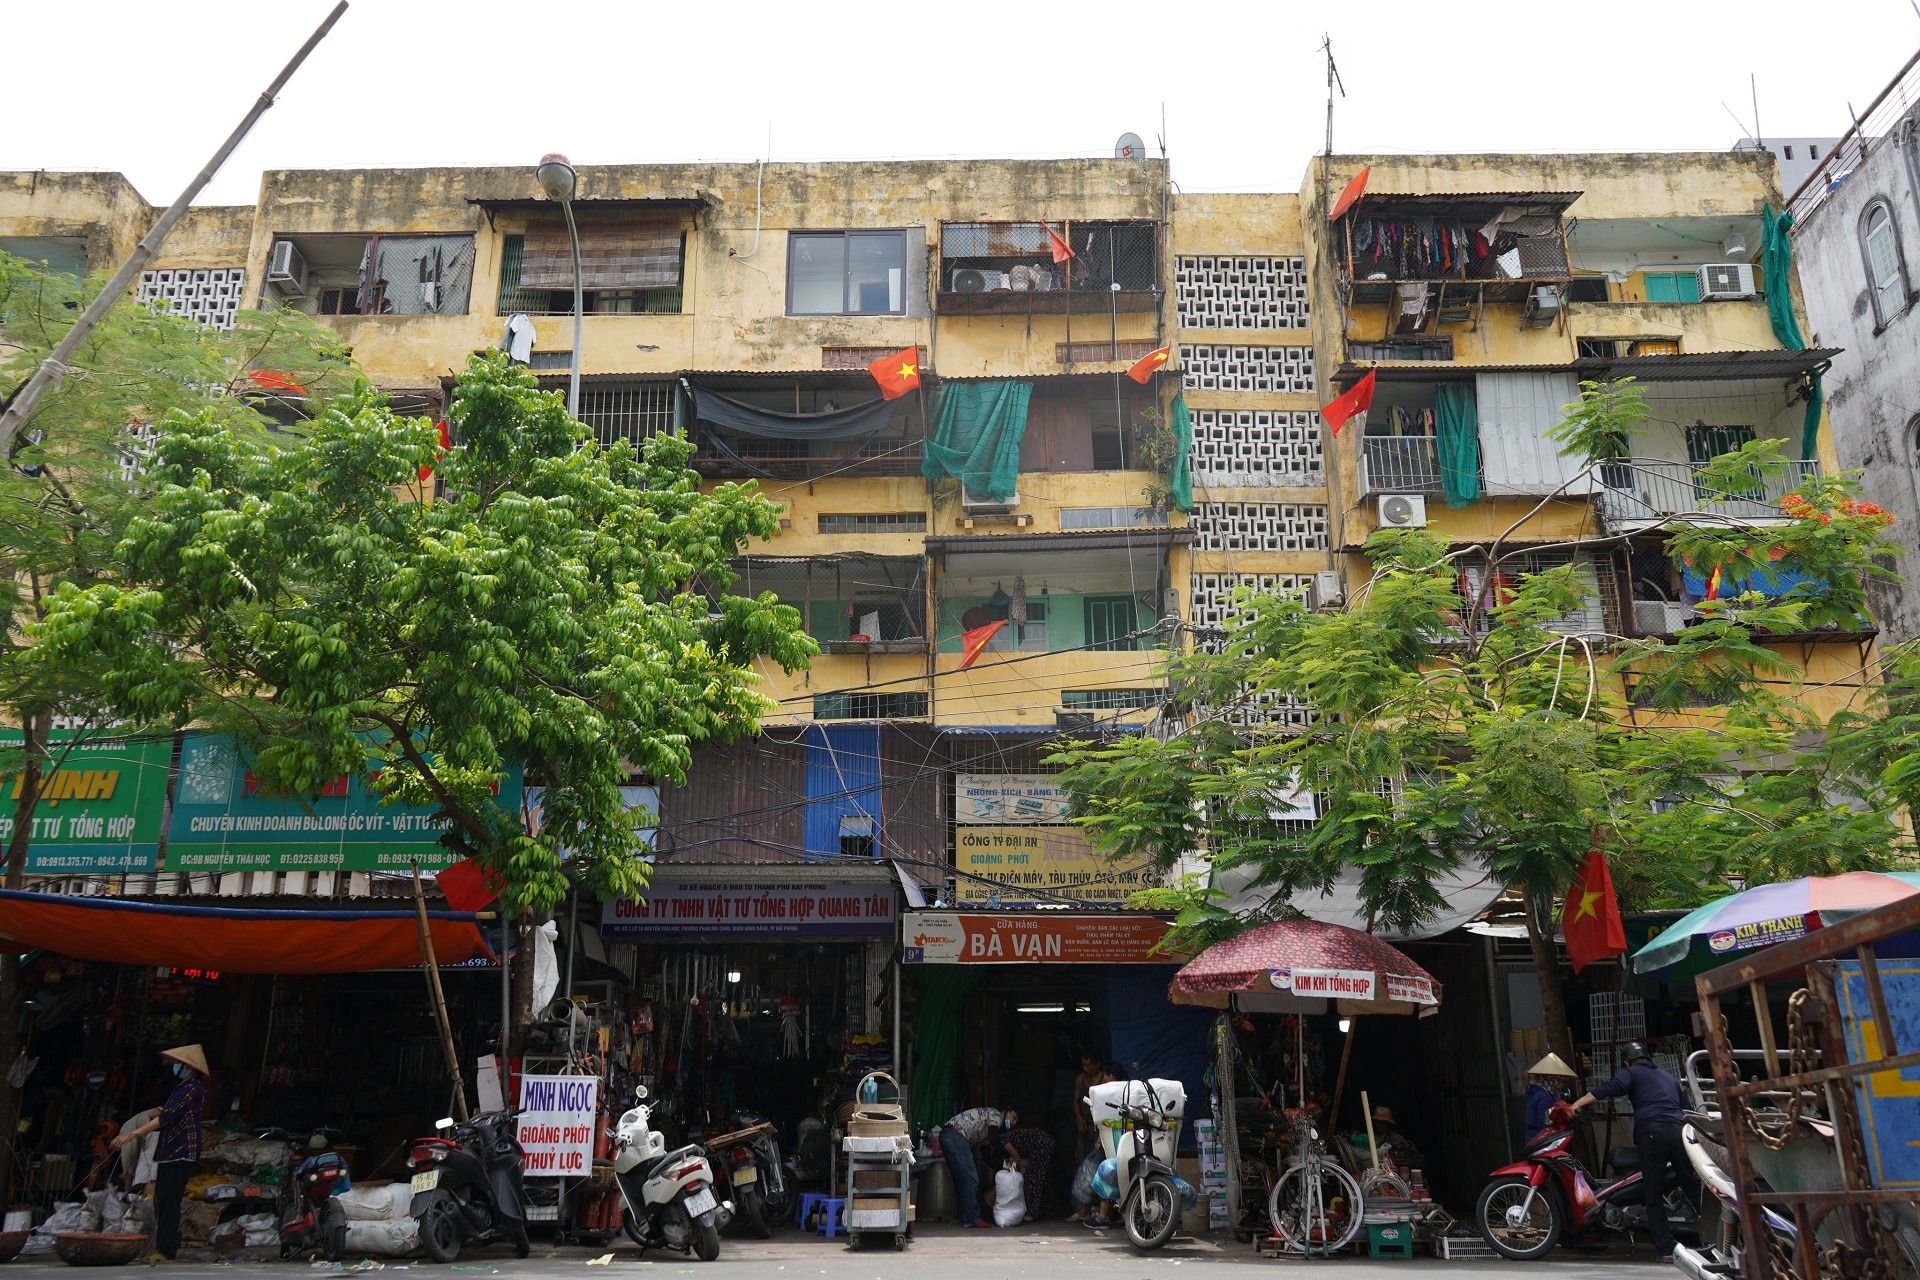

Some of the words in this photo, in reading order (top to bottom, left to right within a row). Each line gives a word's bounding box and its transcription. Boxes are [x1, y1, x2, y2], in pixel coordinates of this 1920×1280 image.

[43, 816, 63, 838] TƯ
[69, 809, 102, 838] TỔNG
[106, 815, 136, 841] HỢP
[190, 814, 234, 832] CHUYÊN
[236, 816, 262, 831] KINH
[264, 816, 301, 831] DOANH
[349, 810, 364, 830] ỐC
[366, 811, 384, 830] VÍT
[392, 813, 415, 833] VẬT
[963, 833, 990, 846] CÔNG
[993, 836, 1004, 846] TY
[1006, 836, 1021, 850] ĐẠI
[1025, 837, 1037, 847] AN
[204, 851, 234, 864] NGUYỄN
[236, 852, 254, 864] THÁI
[255, 854, 271, 866] HỌC
[1007, 852, 1030, 864] PHỚT
[1000, 870, 1020, 885] ĐIỆN
[1049, 870, 1066, 883] TÀU
[654, 899, 668, 918] TY
[672, 899, 704, 918] TNHH
[708, 894, 731, 922] VẬT
[734, 896, 751, 918] TƯ
[753, 891, 786, 918] TỔNG
[790, 896, 814, 922] HỢP
[818, 898, 861, 919] QUANG
[864, 893, 889, 917] TÂN
[1016, 920, 1038, 929] HÀNG
[1734, 924, 1759, 939] KIM
[1760, 915, 1804, 934] THANH
[971, 928, 1003, 956] BÀ
[1011, 934, 1061, 960] VẠN
[1295, 976, 1310, 990] KIM
[1313, 974, 1326, 990] KHÍ
[1329, 972, 1350, 992] TỔNG
[1353, 978, 1370, 996] HỢP
[524, 1081, 556, 1111] MINH
[558, 1082, 592, 1118] NGỌC
[521, 1123, 560, 1143] GIOĂNG
[563, 1124, 590, 1143] PHỚT
[525, 1147, 556, 1169] THUỶ
[559, 1151, 582, 1173] LỰC
